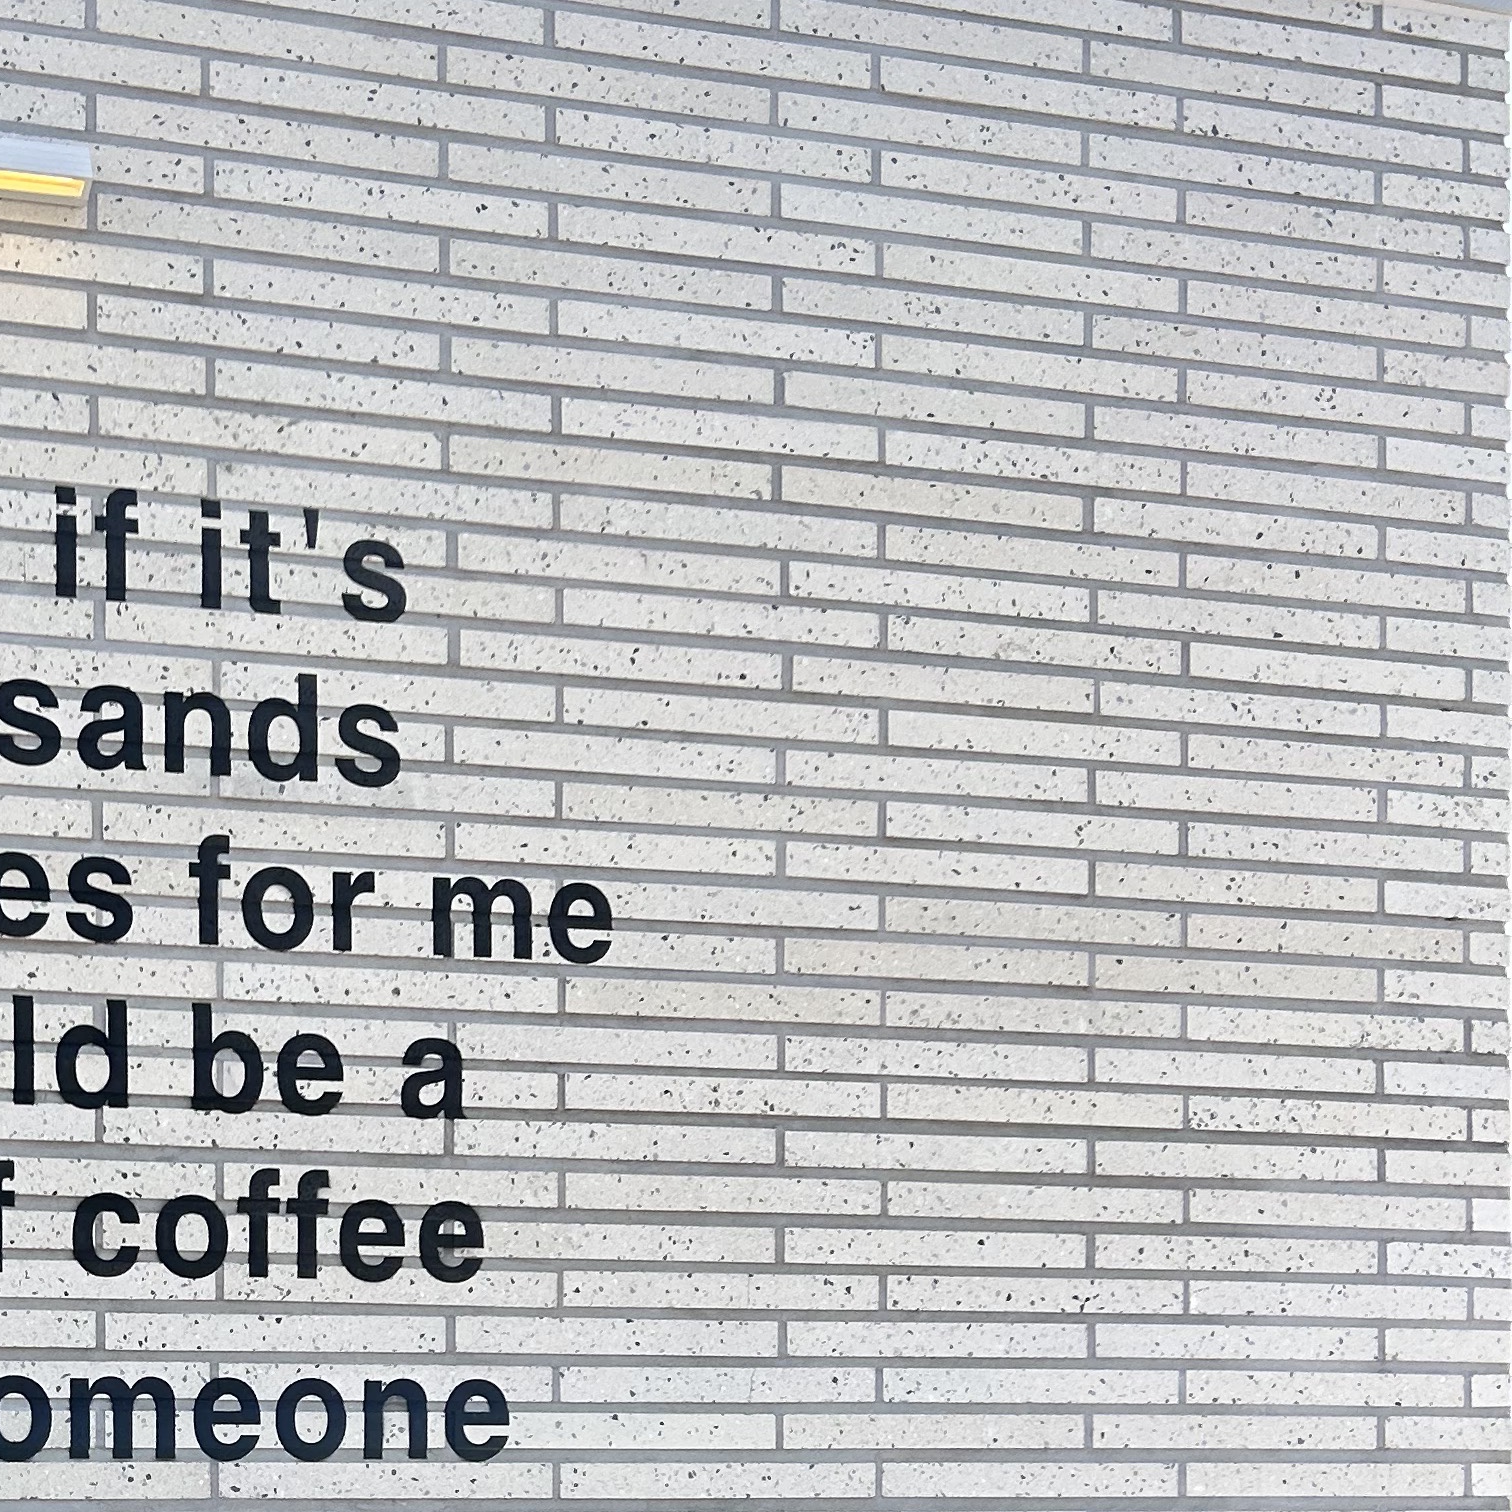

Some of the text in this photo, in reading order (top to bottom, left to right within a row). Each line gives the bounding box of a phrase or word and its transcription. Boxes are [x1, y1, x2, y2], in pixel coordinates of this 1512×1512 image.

[52, 487, 140, 602] if
[198, 499, 408, 624] it's
[187, 834, 377, 954] for
[428, 875, 616, 966] me
[185, 1002, 345, 1118] be
[399, 1036, 470, 1123] a
[71, 1167, 486, 1285] coffee
